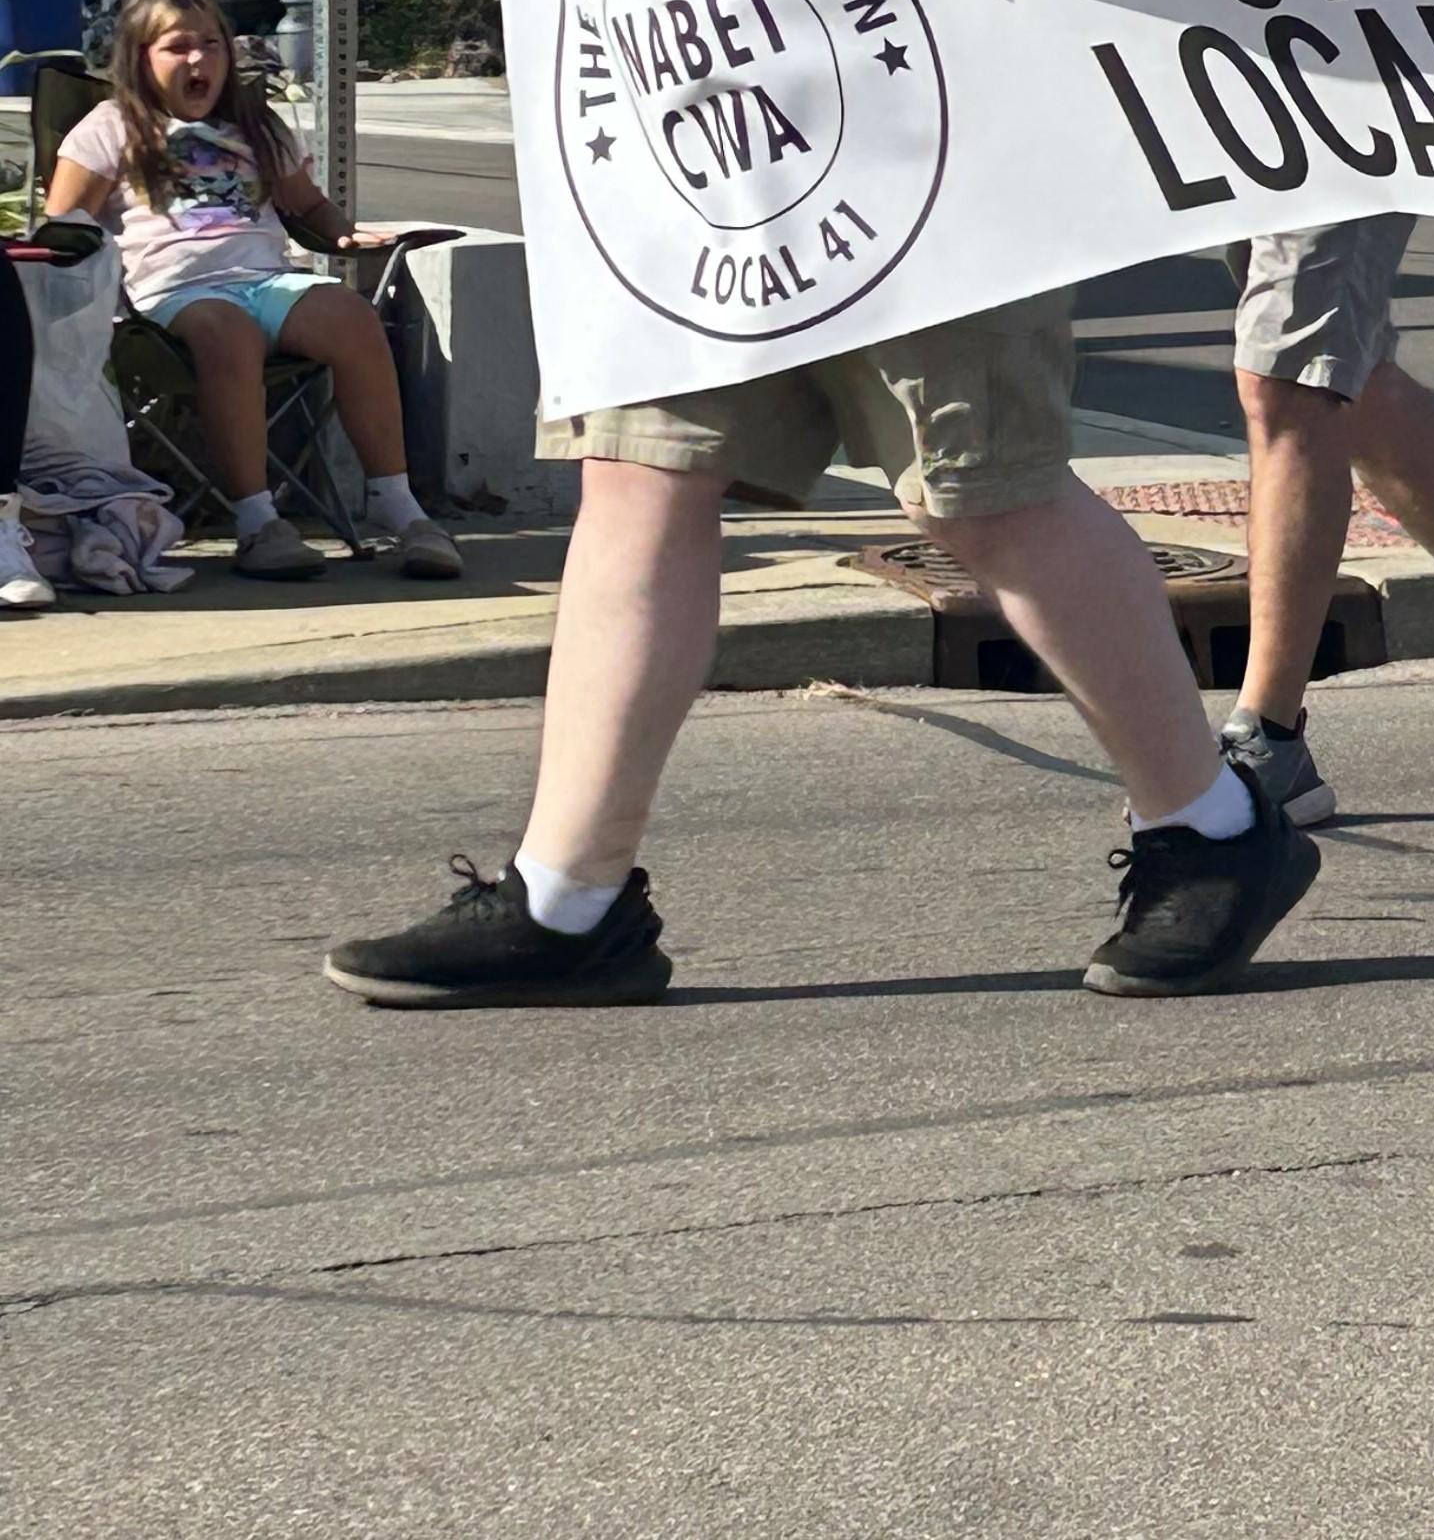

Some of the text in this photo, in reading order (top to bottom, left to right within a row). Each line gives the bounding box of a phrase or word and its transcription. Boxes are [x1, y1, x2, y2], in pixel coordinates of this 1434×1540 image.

[578, 4, 618, 118] THE
[661, 84, 813, 191] CWA
[690, 199, 879, 307] LOCAL 41
